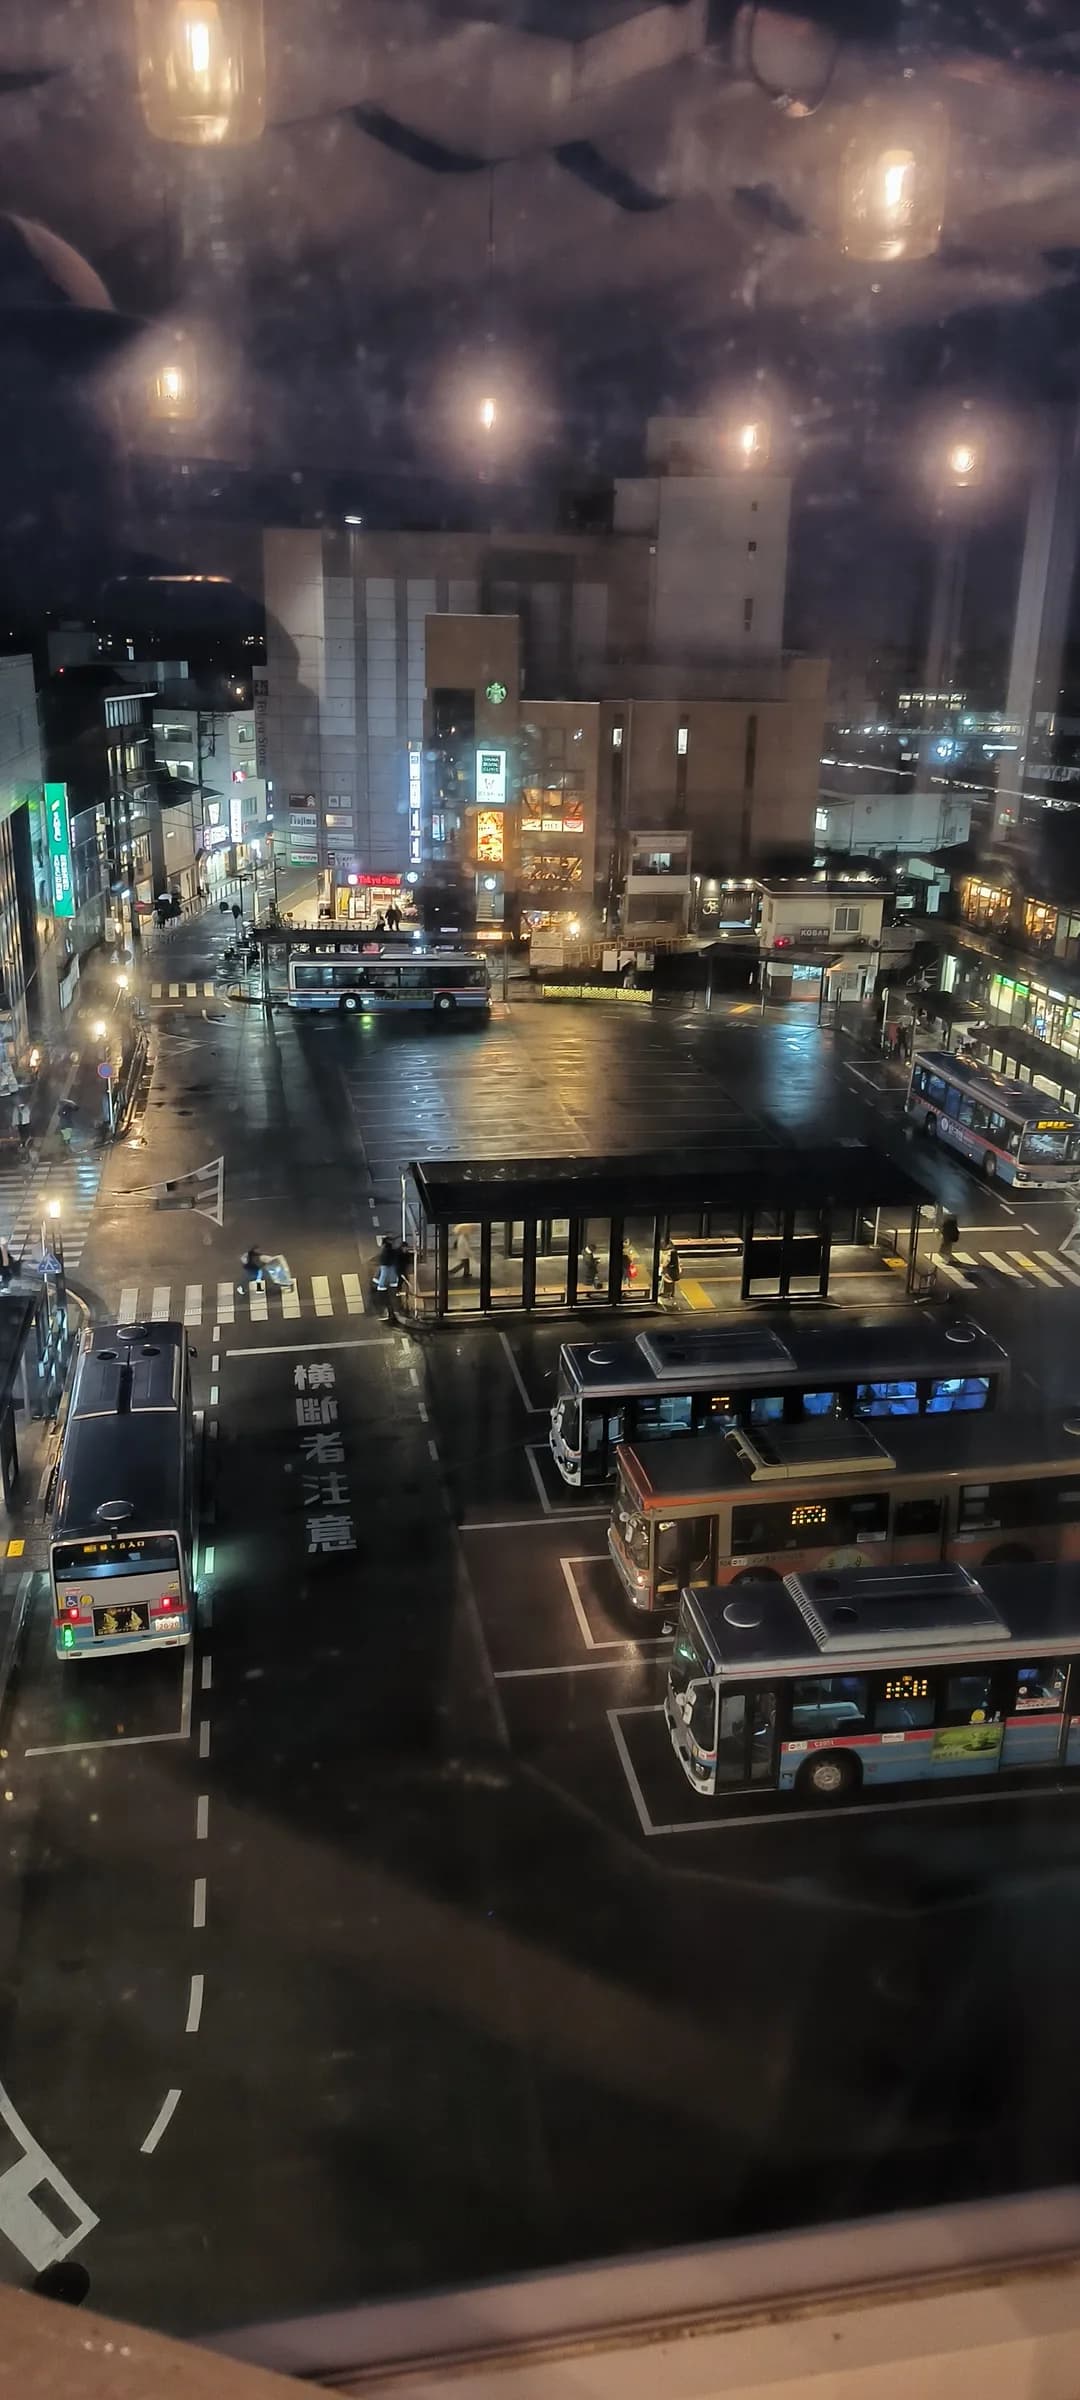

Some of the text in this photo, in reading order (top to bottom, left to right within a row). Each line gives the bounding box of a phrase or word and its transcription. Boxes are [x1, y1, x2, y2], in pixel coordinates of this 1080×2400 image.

[358, 875, 401, 885] Tokyu Store
[800, 929, 829, 937] KOBAN
[293, 1363, 358, 1553] 横断者注意
